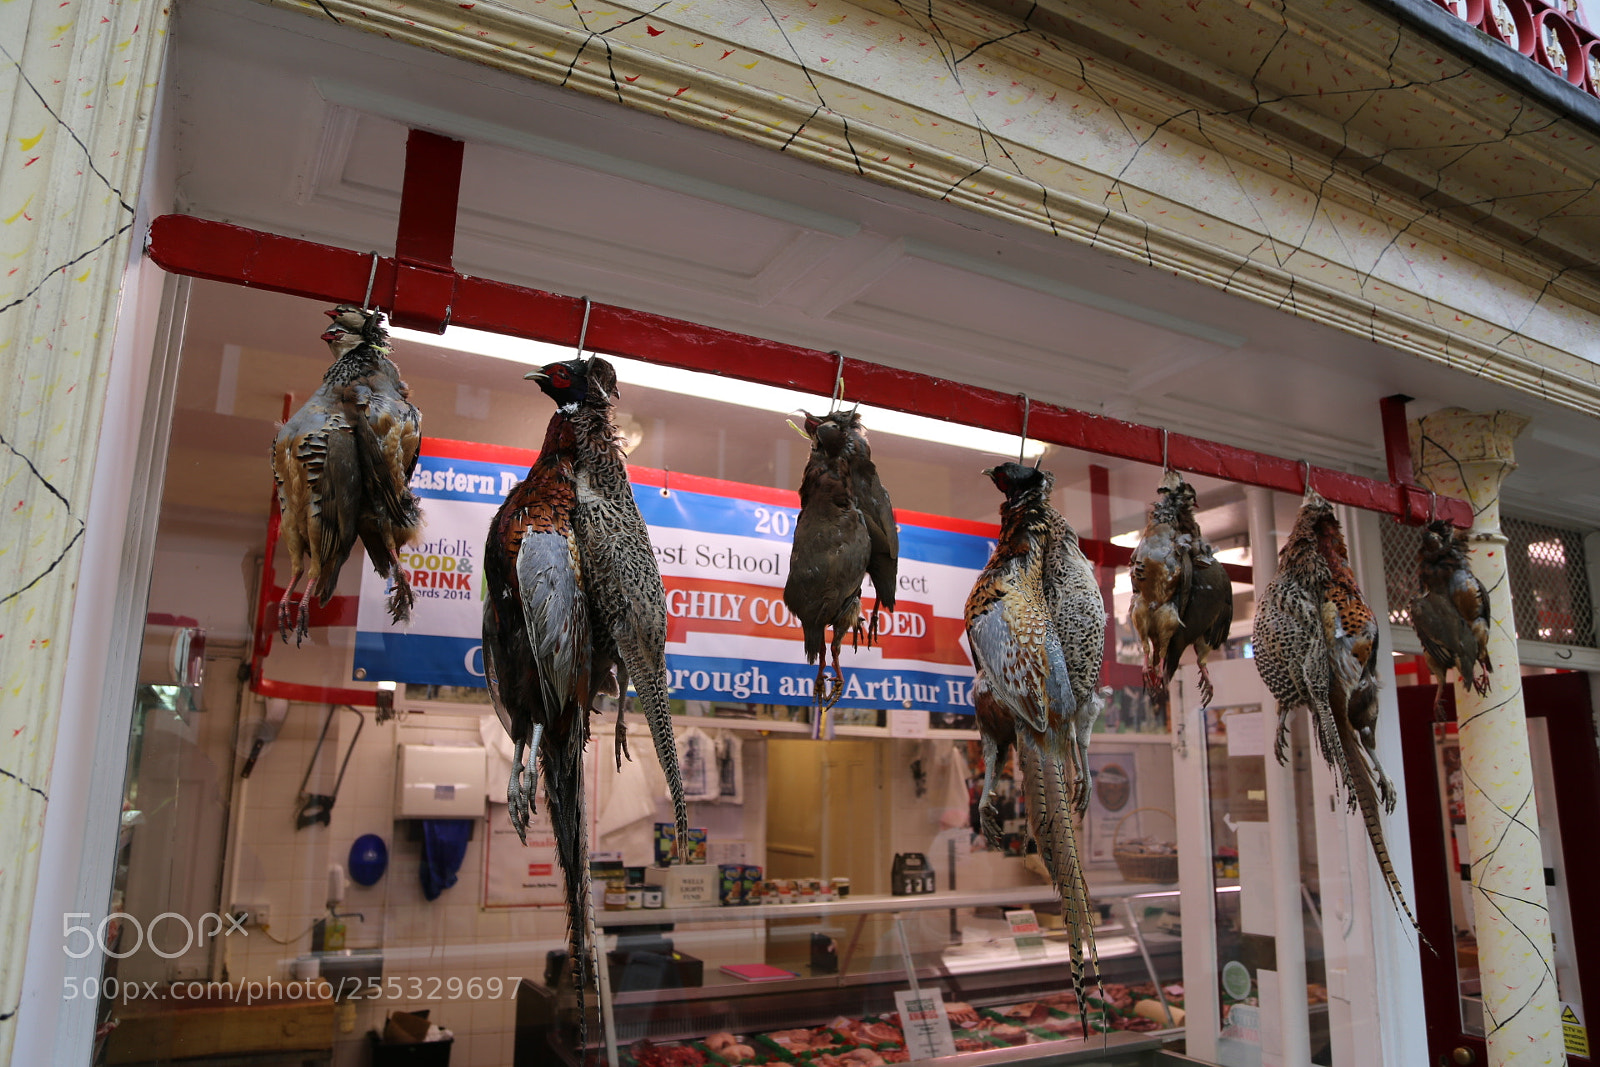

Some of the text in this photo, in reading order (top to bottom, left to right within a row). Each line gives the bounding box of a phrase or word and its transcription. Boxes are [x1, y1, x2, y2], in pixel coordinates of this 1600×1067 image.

[409, 463, 496, 495] Eastern
[651, 544, 687, 565] est
[695, 544, 781, 576] School
[443, 589, 472, 601] 2014
[664, 588, 747, 622] GHLY
[842, 673, 941, 704] Arthur
